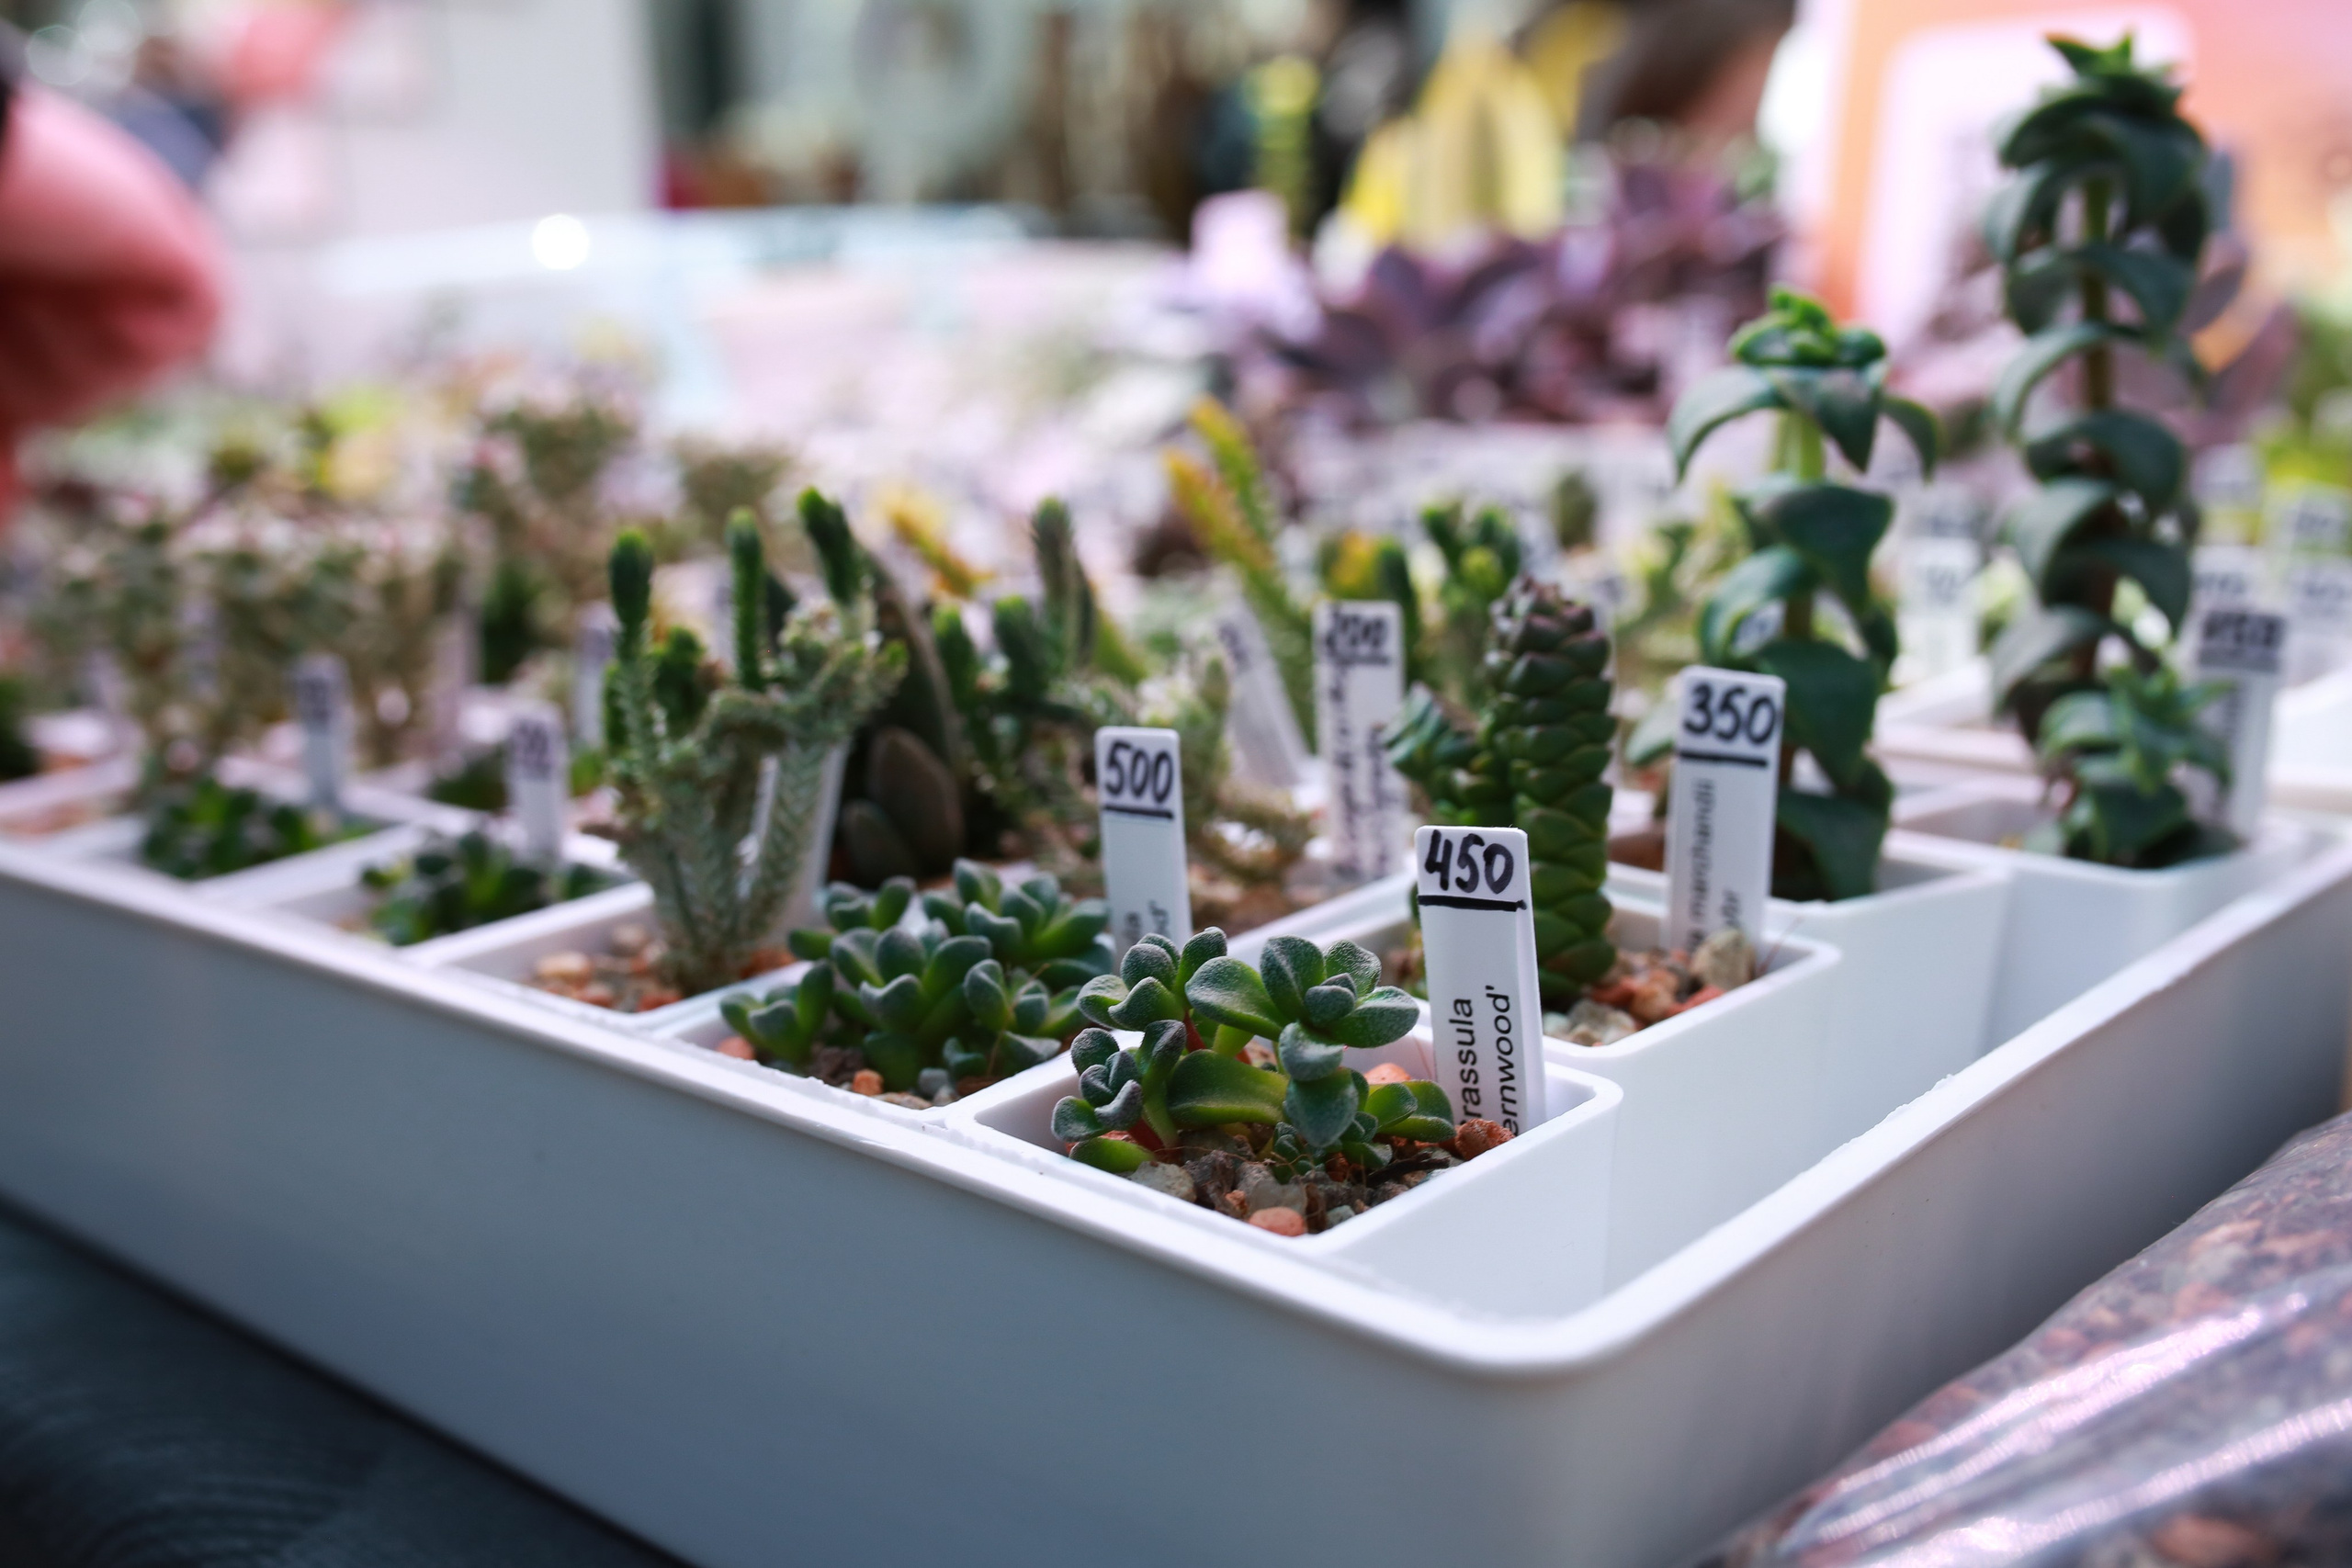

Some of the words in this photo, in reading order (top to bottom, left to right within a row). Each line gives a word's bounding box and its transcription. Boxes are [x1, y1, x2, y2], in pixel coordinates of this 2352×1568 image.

[1683, 683, 1776, 745] 350
[1105, 740, 1174, 804] 500
[1424, 829, 1515, 895] 450
[1448, 998, 1481, 1125] rassula
